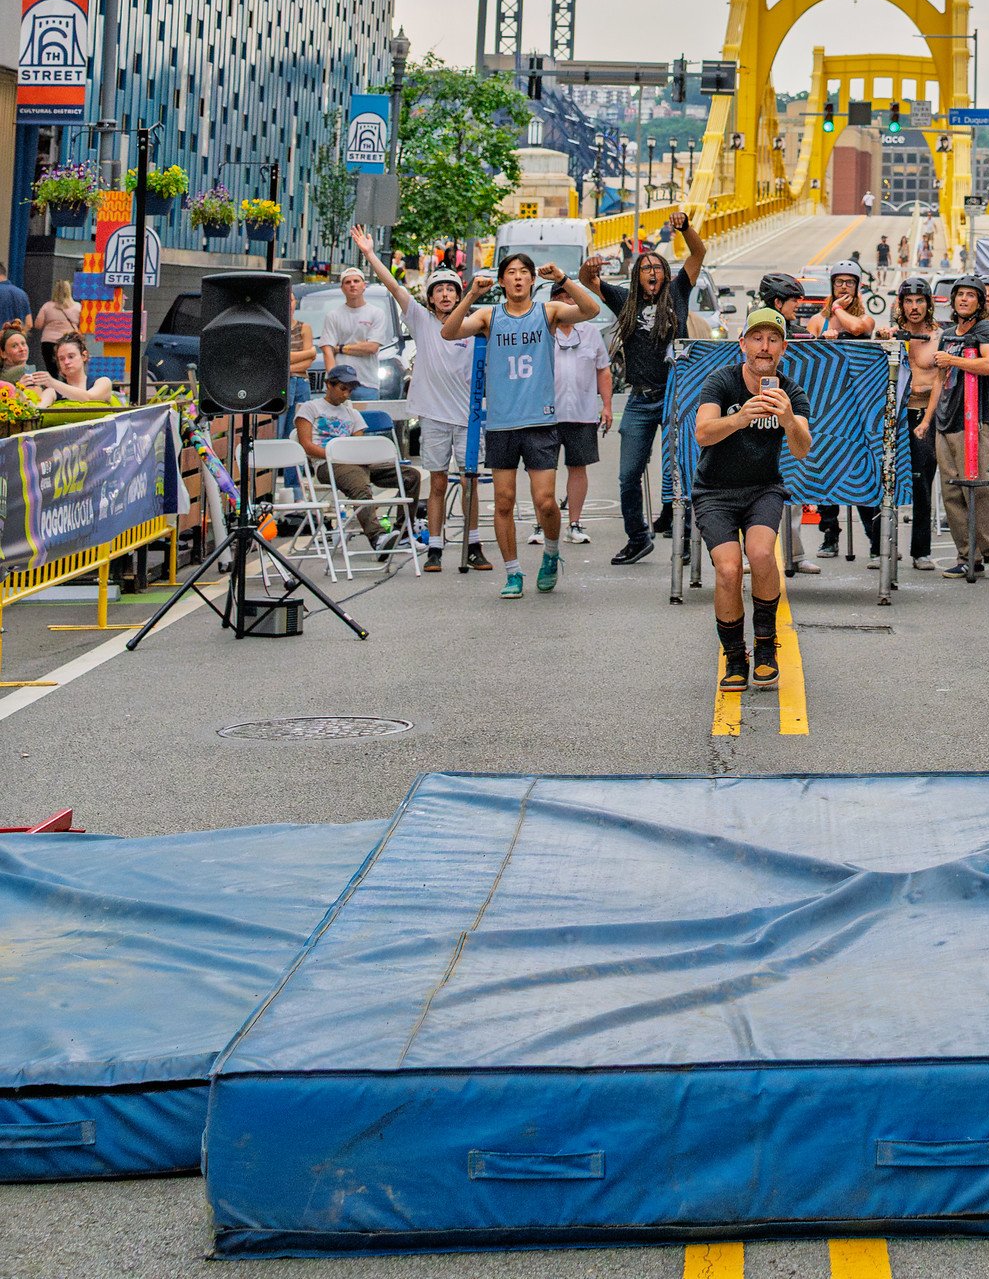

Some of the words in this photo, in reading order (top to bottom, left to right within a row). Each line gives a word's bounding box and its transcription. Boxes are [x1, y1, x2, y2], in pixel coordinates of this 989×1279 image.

[21, 70, 83, 81] STREET
[881, 134, 906, 144] lace
[108, 274, 153, 284] STRT
[496, 332, 518, 347] THE
[521, 330, 543, 345] BAY
[507, 354, 533, 380] 16
[471, 359, 485, 423] vurtego
[53, 443, 89, 500] 2025
[40, 496, 95, 540] POGOPALOOZA
